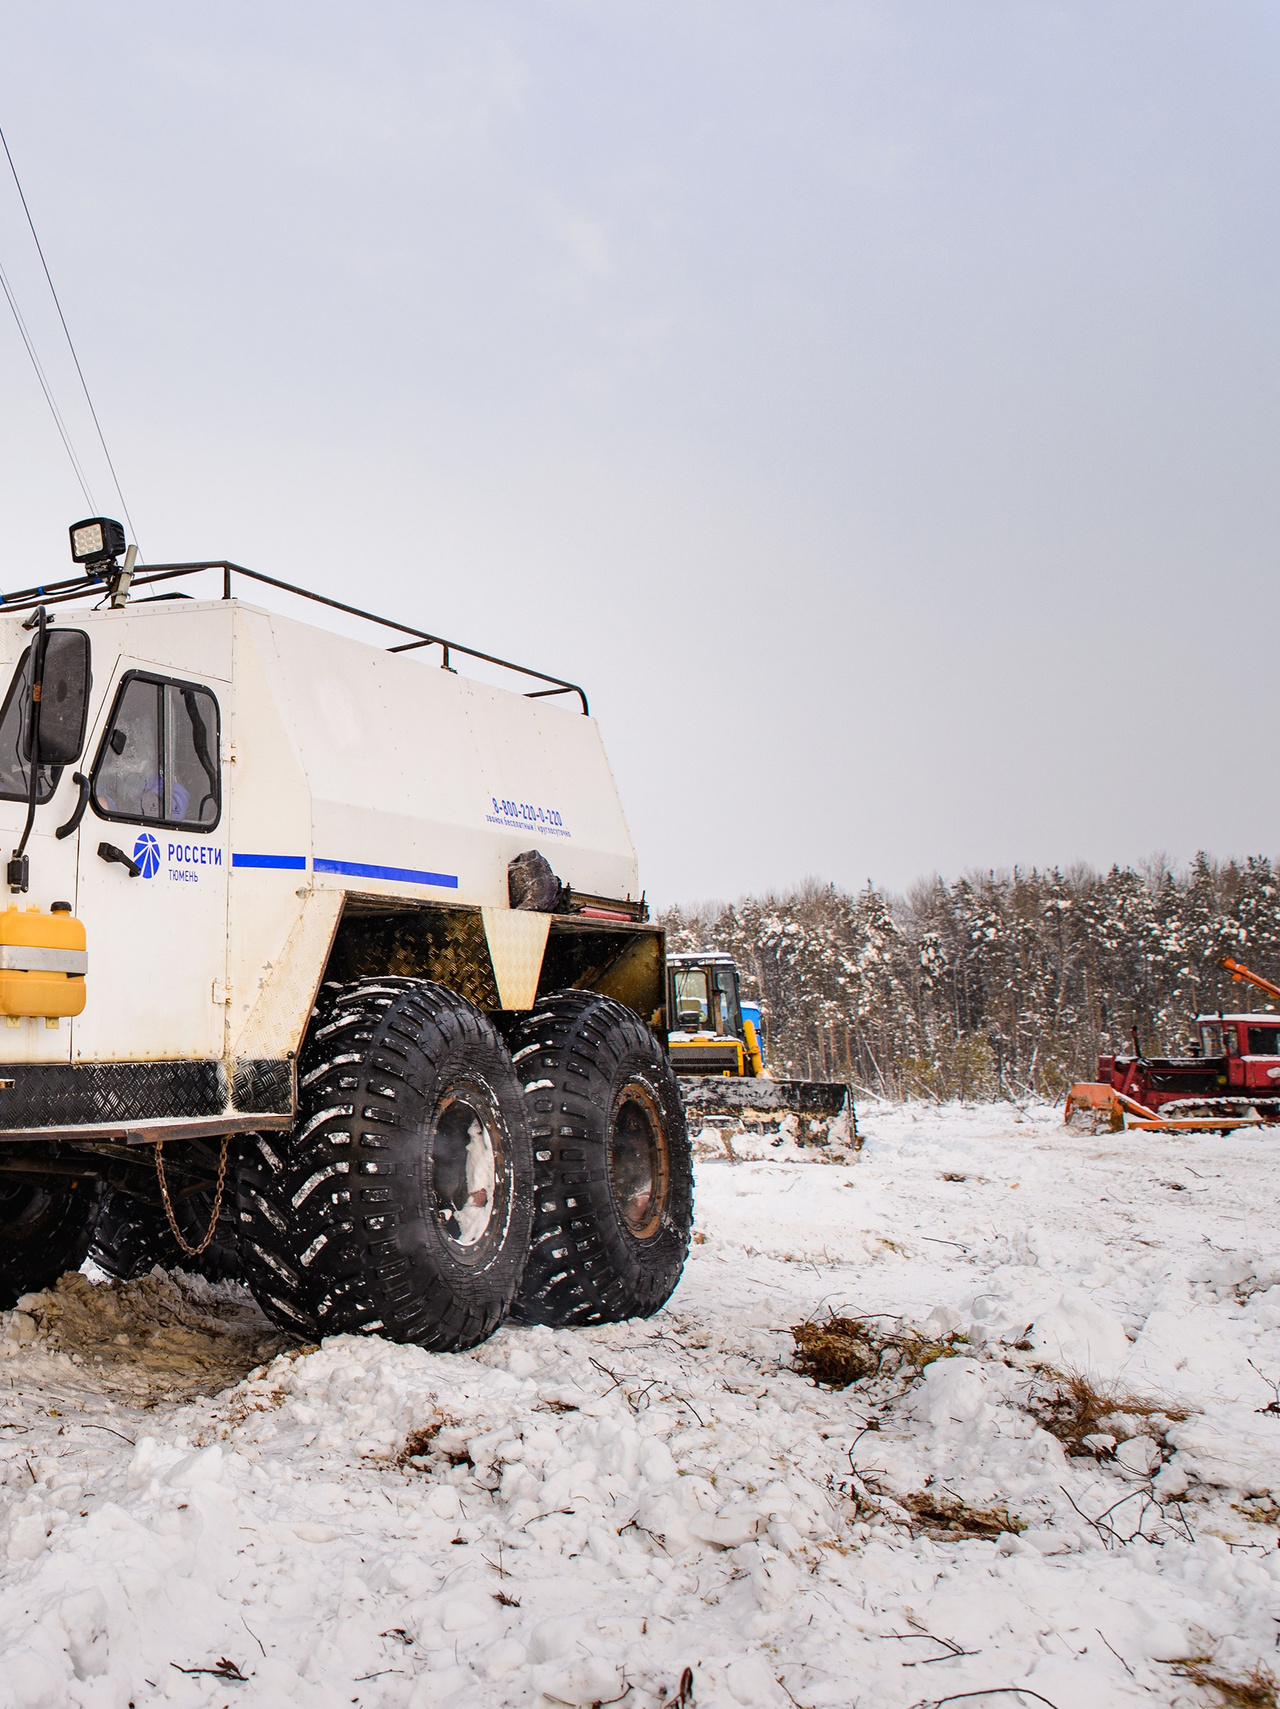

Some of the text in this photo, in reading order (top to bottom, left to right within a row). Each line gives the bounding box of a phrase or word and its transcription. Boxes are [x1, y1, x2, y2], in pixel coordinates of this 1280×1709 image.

[492, 797, 563, 826] 8-800-220-0-220
[168, 843, 222, 865] РОССЕТИ
[168, 869, 199, 883] ТЮМЕНЬ
